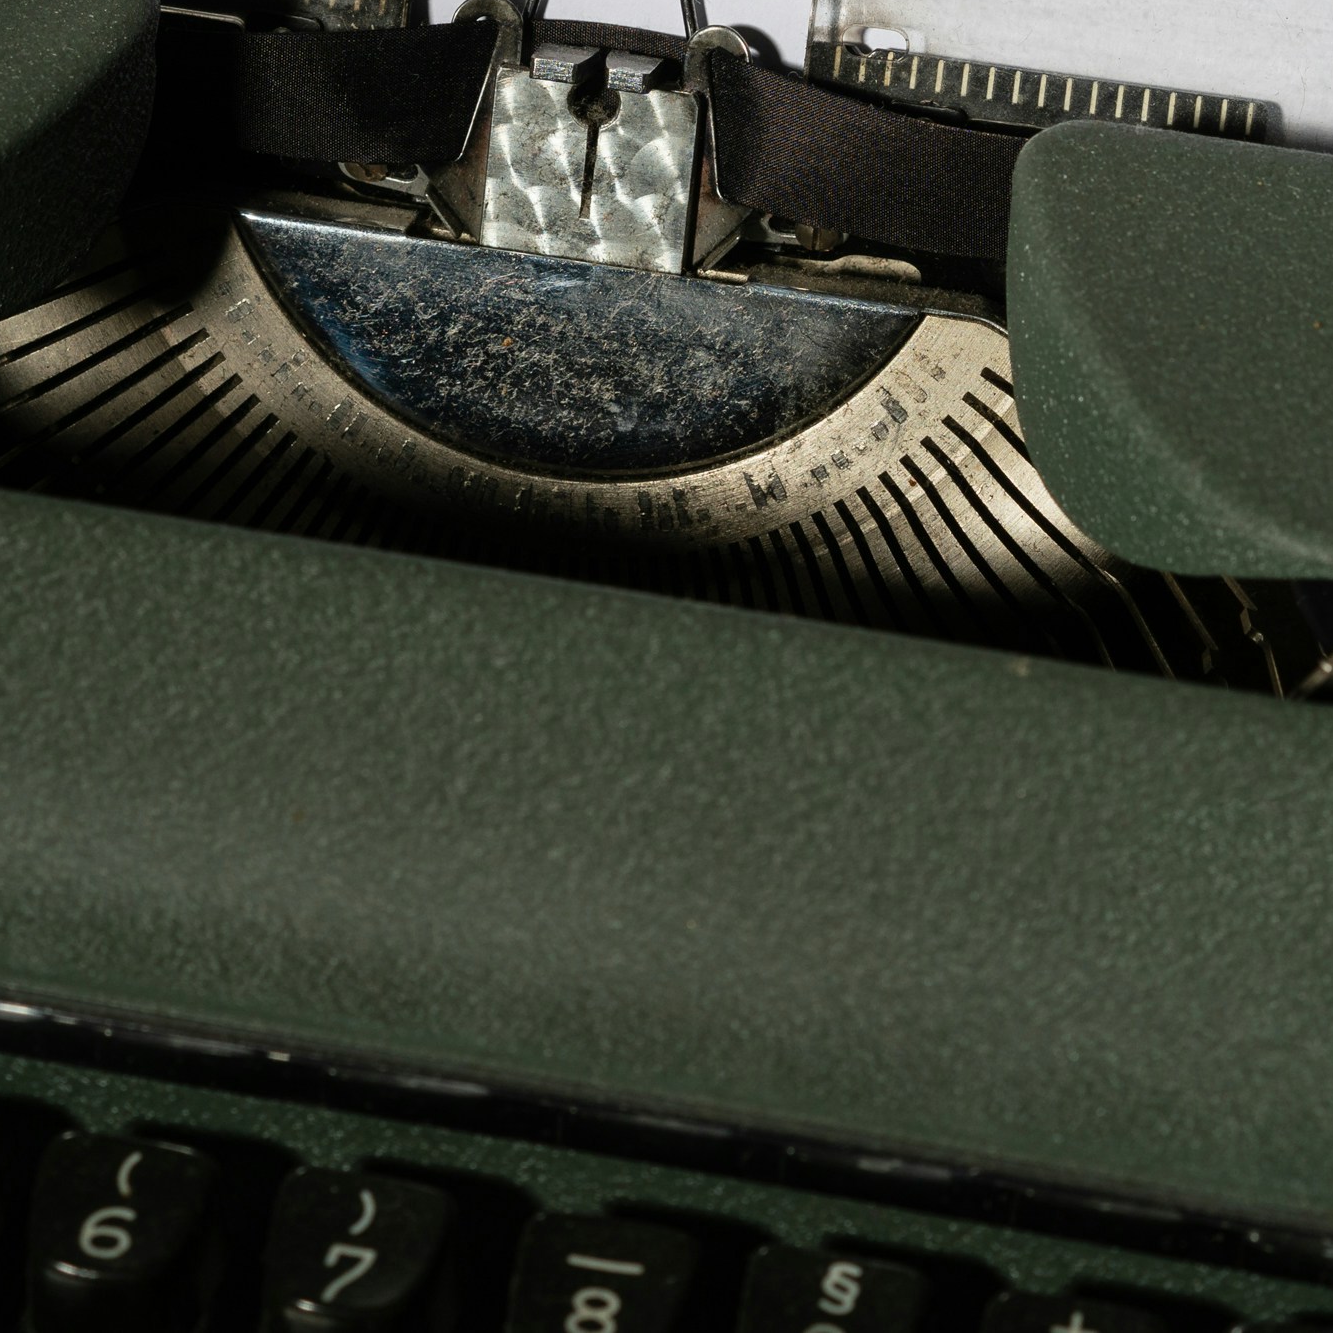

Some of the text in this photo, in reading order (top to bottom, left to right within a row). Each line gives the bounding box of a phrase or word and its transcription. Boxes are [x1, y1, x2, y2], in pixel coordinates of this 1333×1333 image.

[116, 1151, 143, 1196] (
[78, 1206, 137, 1260] 6
[348, 1189, 376, 1236] )
[322, 1243, 377, 1302] 7
[818, 1260, 863, 1316] §
